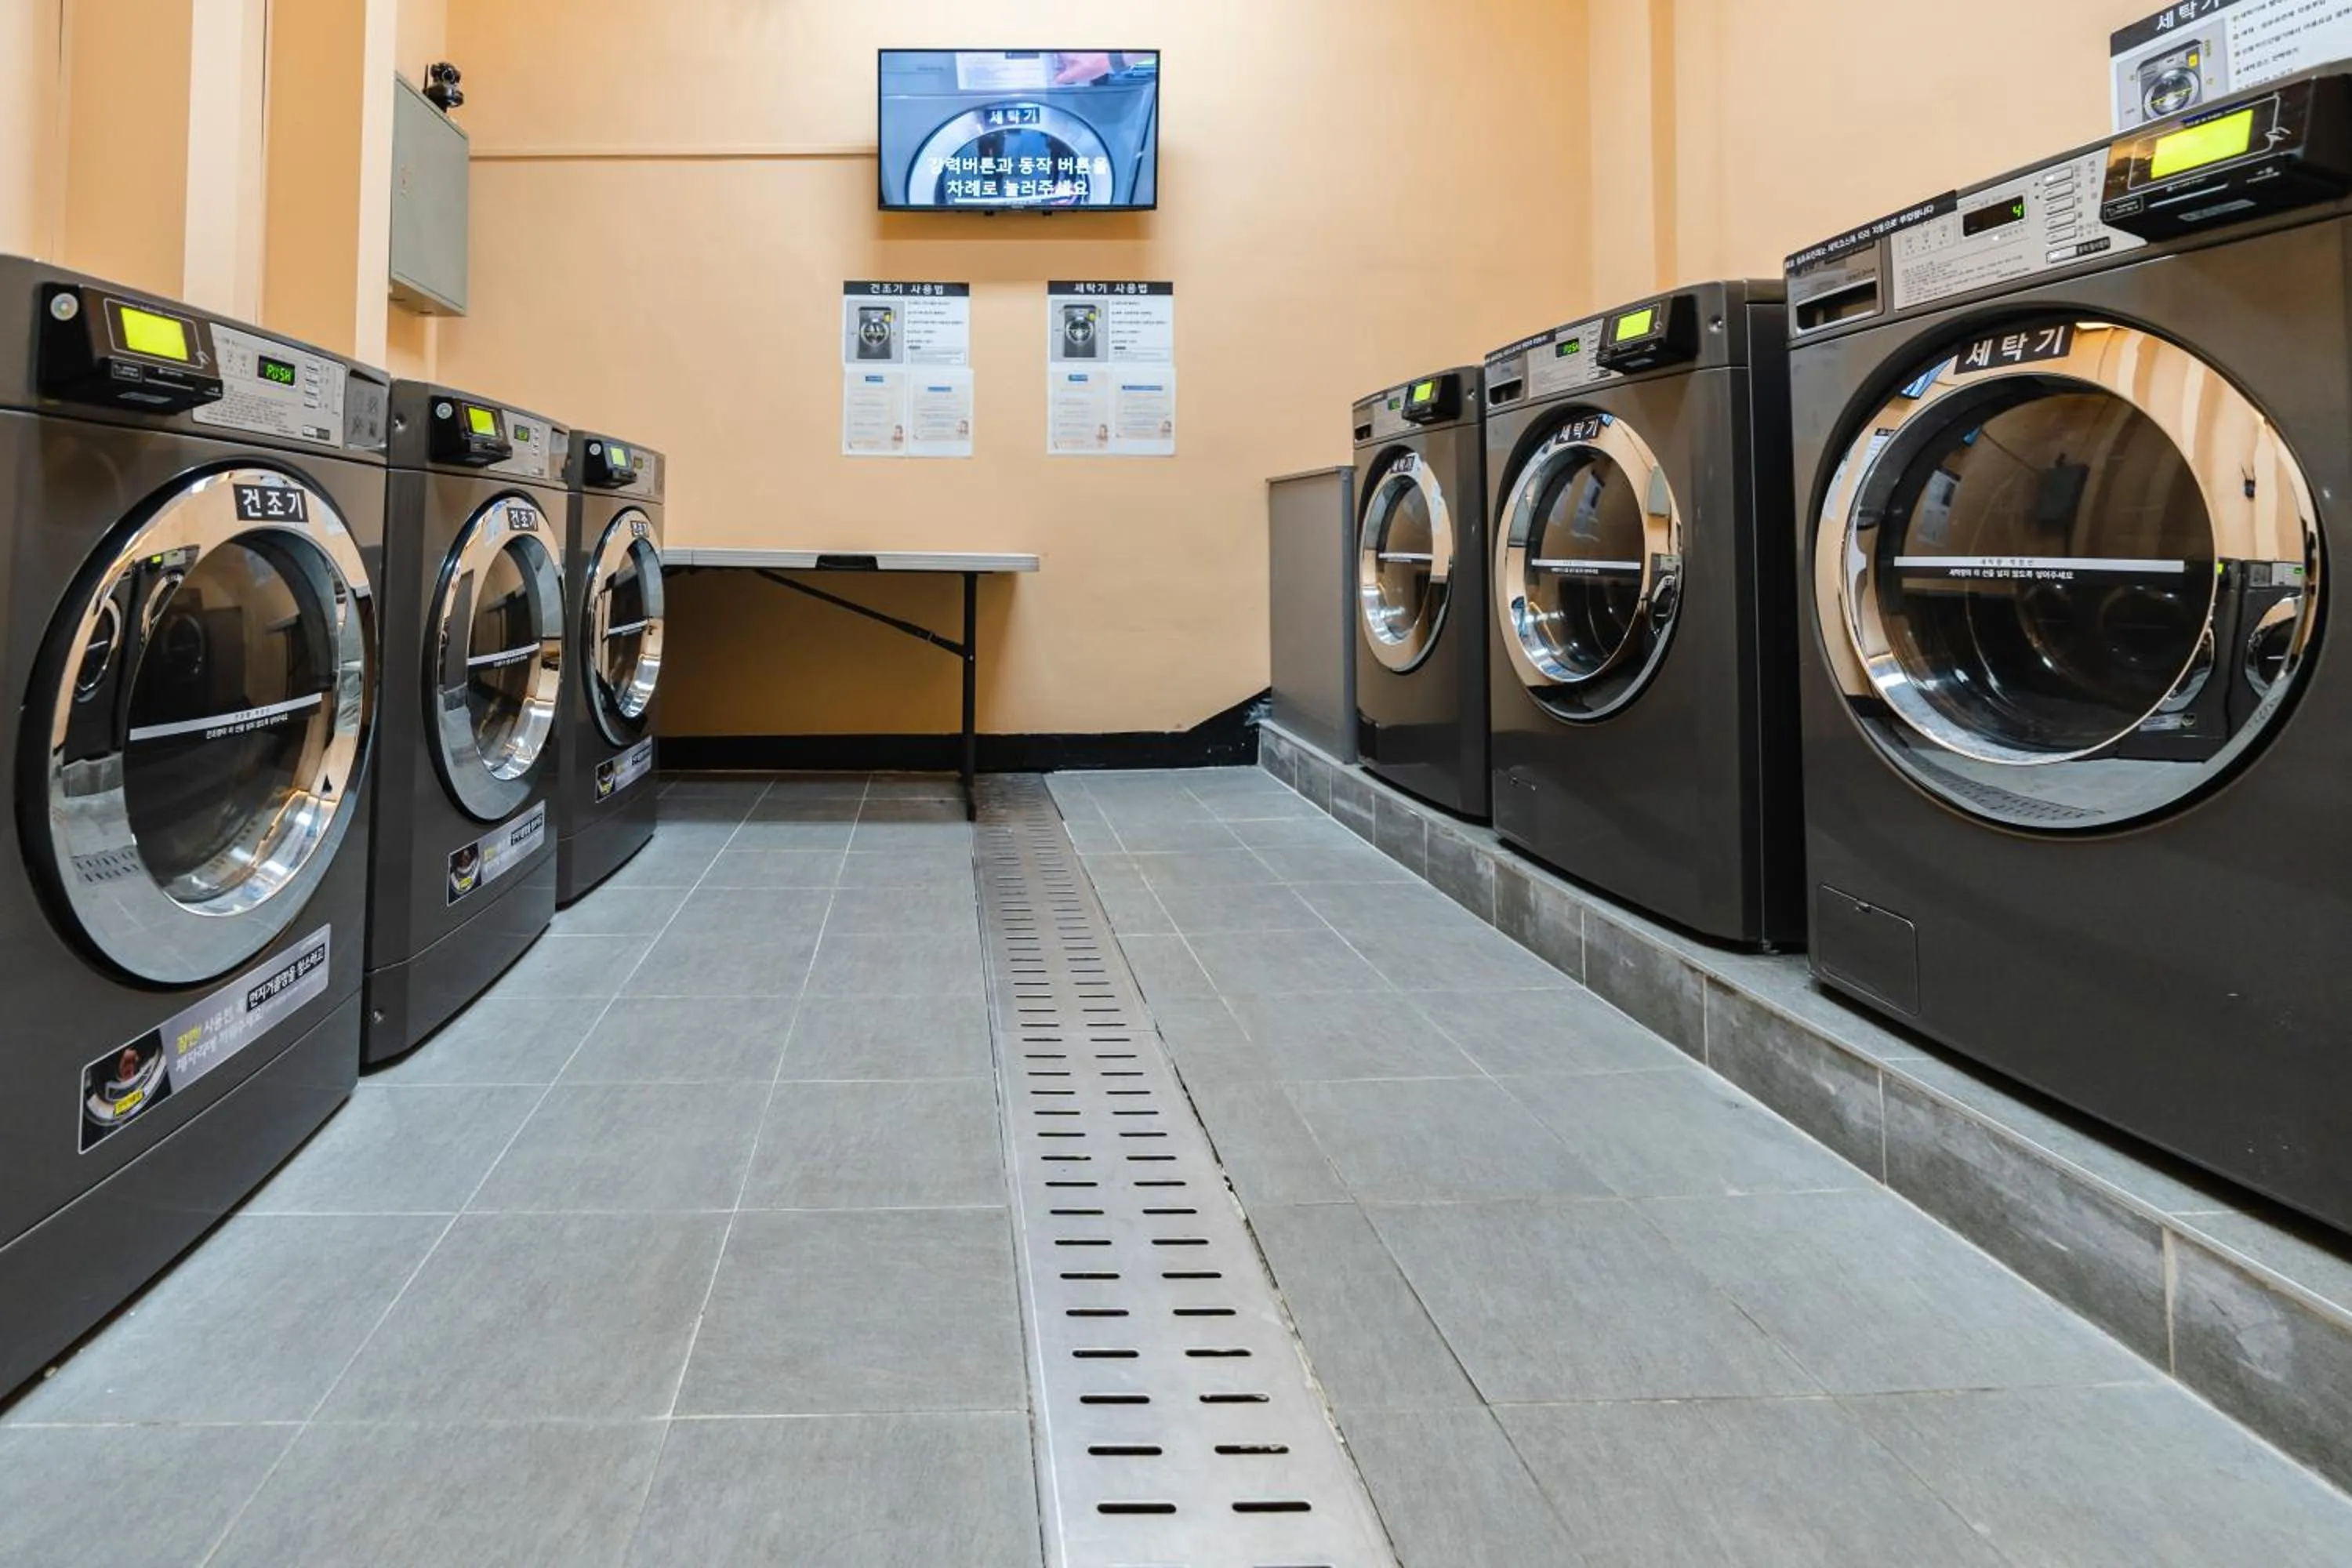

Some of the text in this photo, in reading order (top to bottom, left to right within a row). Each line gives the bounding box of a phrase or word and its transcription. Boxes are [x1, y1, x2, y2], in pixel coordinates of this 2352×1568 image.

[989, 109, 1036, 124] 세탁기
[1019, 157, 1053, 174] 동작
[1058, 157, 1108, 174] 버튼을
[947, 180, 998, 197] 차례로
[870, 284, 944, 295] 건조기 사용법
[1074, 284, 1148, 294] 세탁기 사용법
[1965, 325, 2067, 367] 세탁기
[266, 363, 292, 382] PUSH
[1559, 419, 1599, 440] 세탁기
[242, 487, 306, 519] 건조기
[510, 510, 536, 529] 건조기
